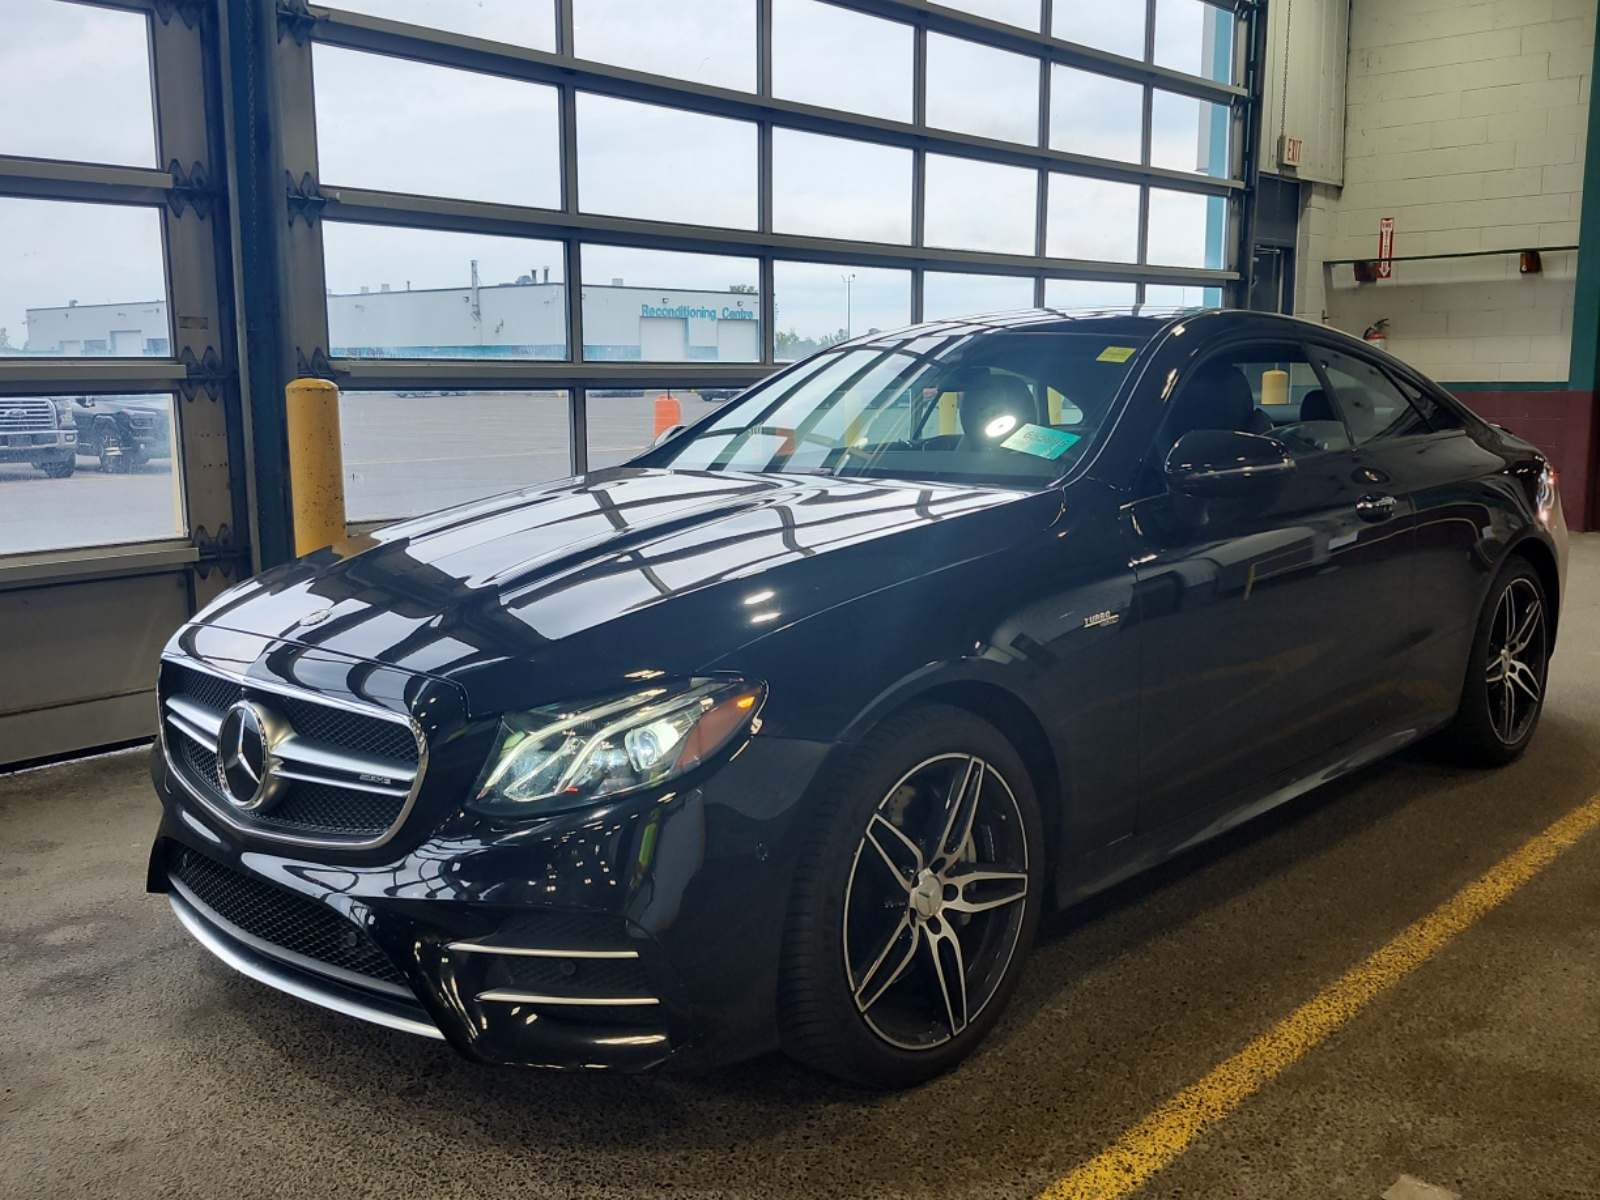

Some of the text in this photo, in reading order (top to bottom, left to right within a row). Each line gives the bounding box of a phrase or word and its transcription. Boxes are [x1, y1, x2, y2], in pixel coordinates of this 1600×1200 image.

[1287, 138, 1302, 162] EXIT
[641, 304, 754, 321] Reconditioning Centre
[1083, 609, 1111, 626] TURBO
